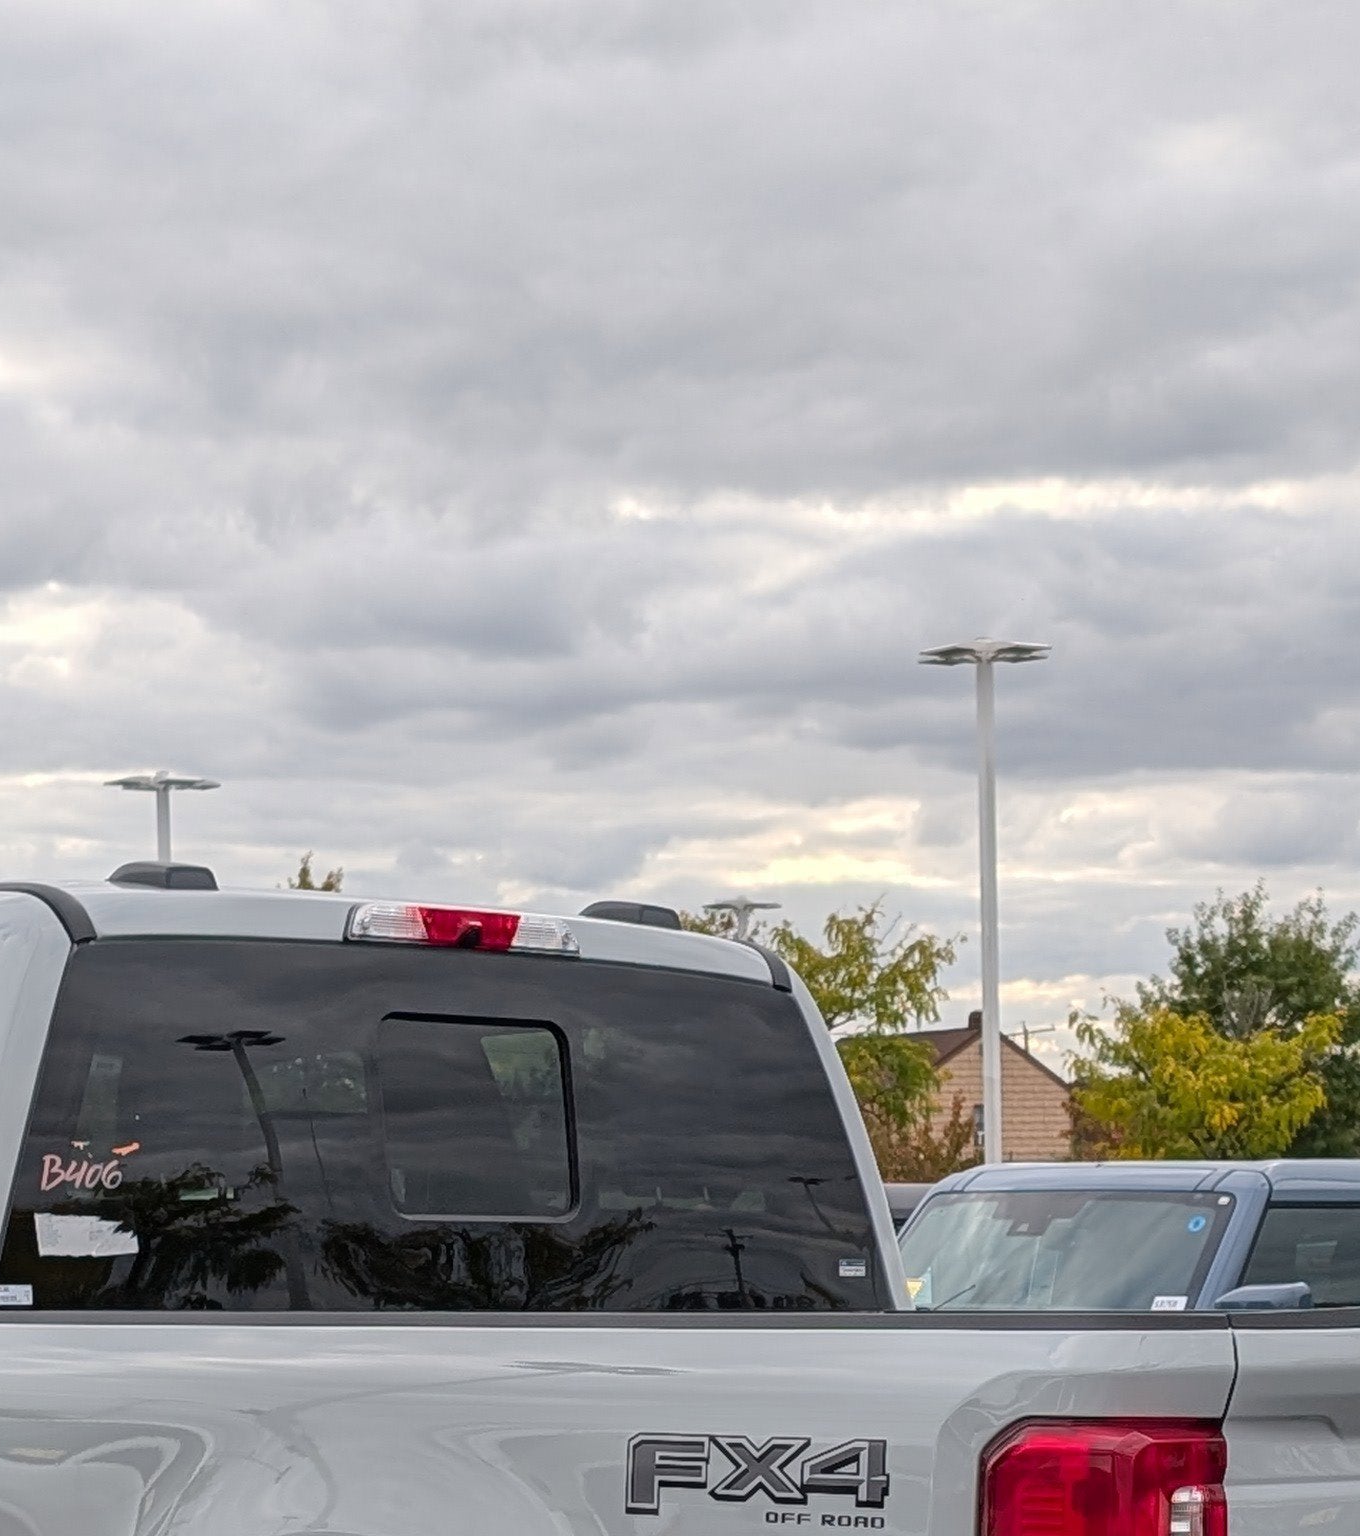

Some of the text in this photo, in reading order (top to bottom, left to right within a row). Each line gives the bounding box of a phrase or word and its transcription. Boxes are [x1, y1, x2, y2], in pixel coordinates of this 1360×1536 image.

[41, 1154, 123, 1191] B406
[625, 1432, 890, 1515] FX4
[765, 1511, 885, 1529] OFF ROAD
